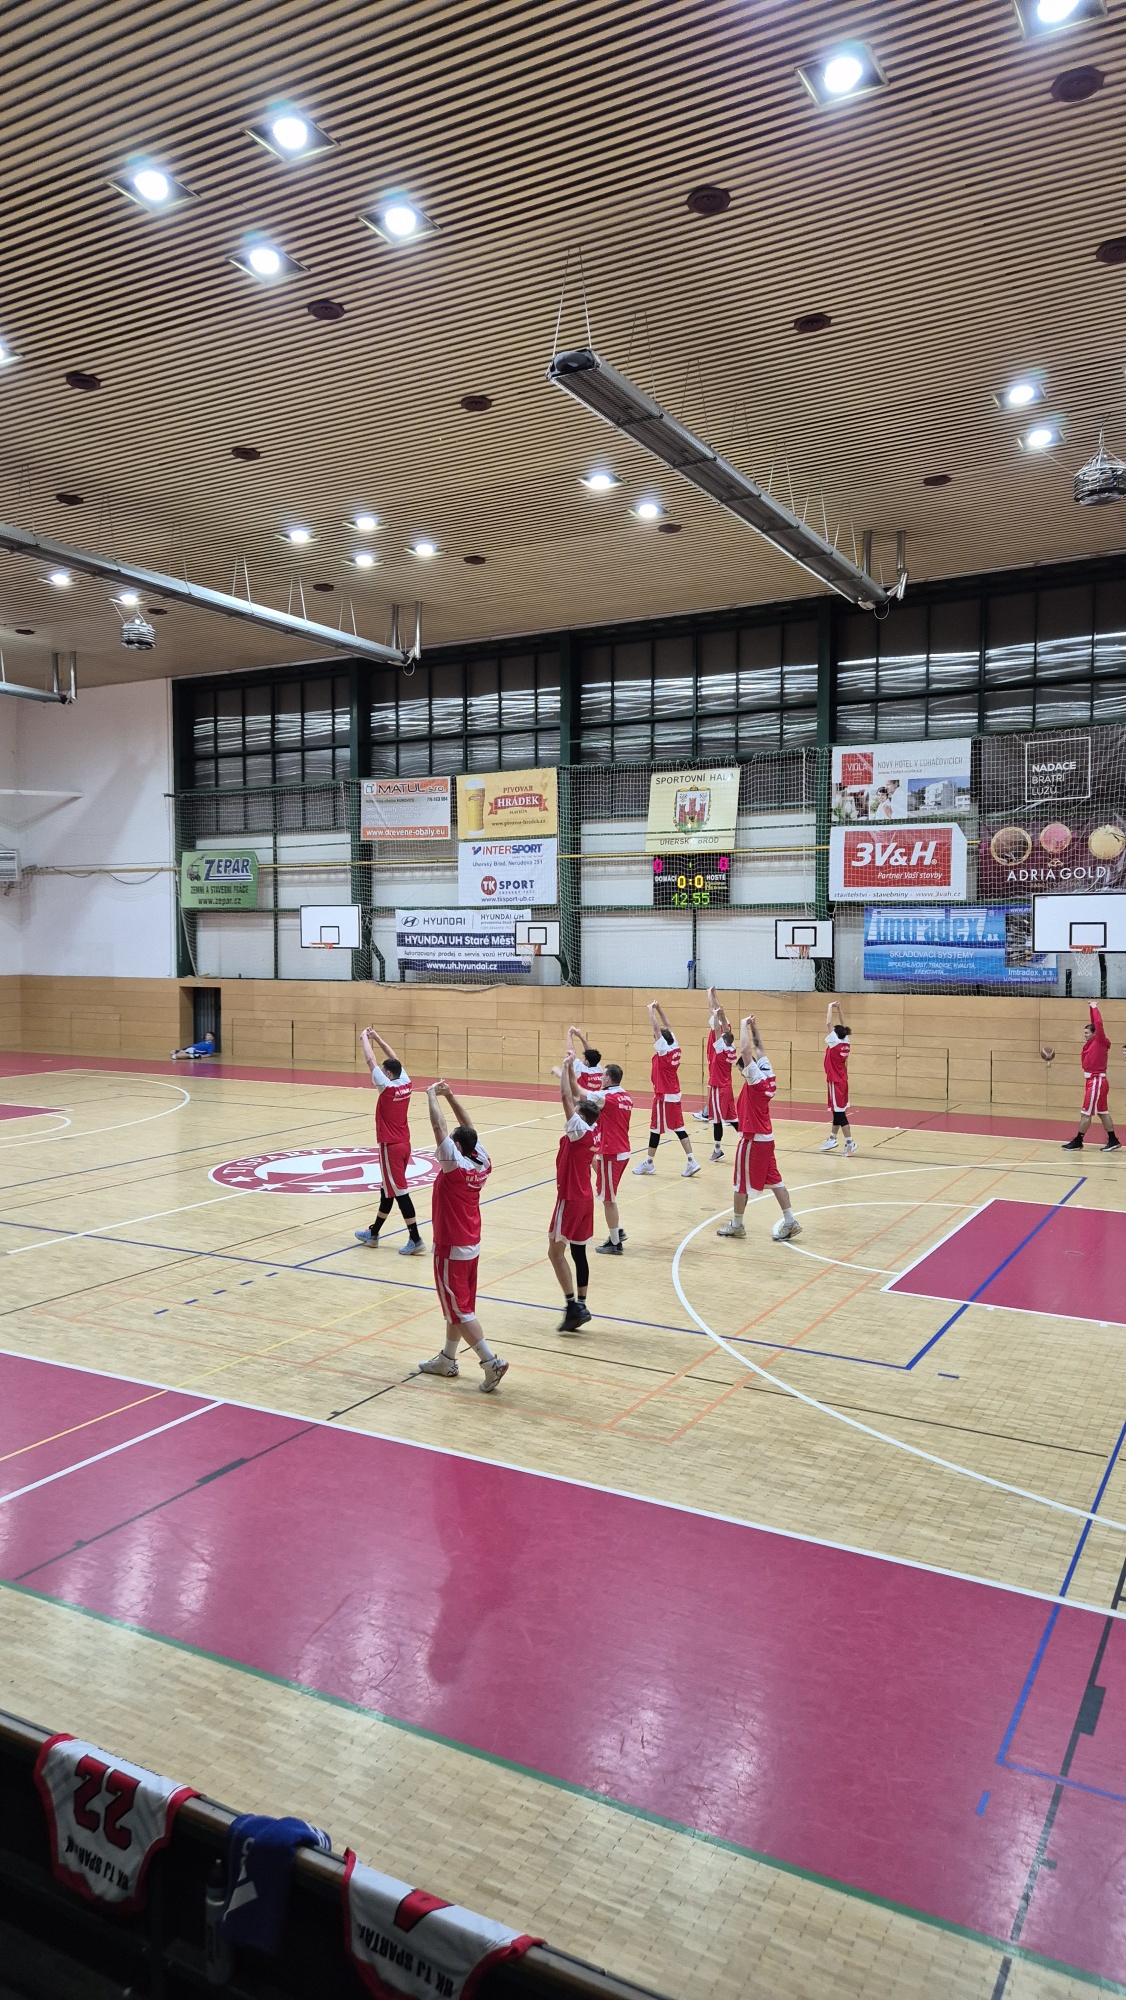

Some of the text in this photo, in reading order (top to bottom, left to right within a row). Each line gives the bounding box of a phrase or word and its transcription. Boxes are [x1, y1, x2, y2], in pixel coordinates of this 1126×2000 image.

[894, 759, 913, 768] HOTEL
[1032, 761, 1077, 773] NADACE
[655, 772, 735, 785] SPORTOVNÍ HALA
[378, 782, 425, 794] MATUL
[503, 785, 533, 794] PIVOVAR
[497, 795, 539, 807] HRÁDEK
[366, 828, 445, 837] www.drevene-obaly.eu
[660, 837, 694, 846] UHERSK
[482, 844, 543, 855] INTERSPORT
[203, 858, 250, 881] ZEPAR
[653, 858, 663, 873] 0
[719, 857, 729, 871] 0
[878, 872, 903, 880] Partner
[919, 871, 943, 880] stavby
[1007, 866, 1107, 881] ADRIA GOLD
[482, 879, 535, 891] TK SPORT
[423, 917, 466, 926] HYUNDAI
[405, 934, 516, 945] HYUNDAI UH Staré Měst
[438, 950, 456, 958] prodej
[426, 960, 498, 971] www.uh.hyundai.cz
[73, 1754, 143, 1850] 22
[102, 1860, 116, 1884] TJ
[415, 1960, 433, 1985] TJ
[436, 1973, 454, 1998] BK
